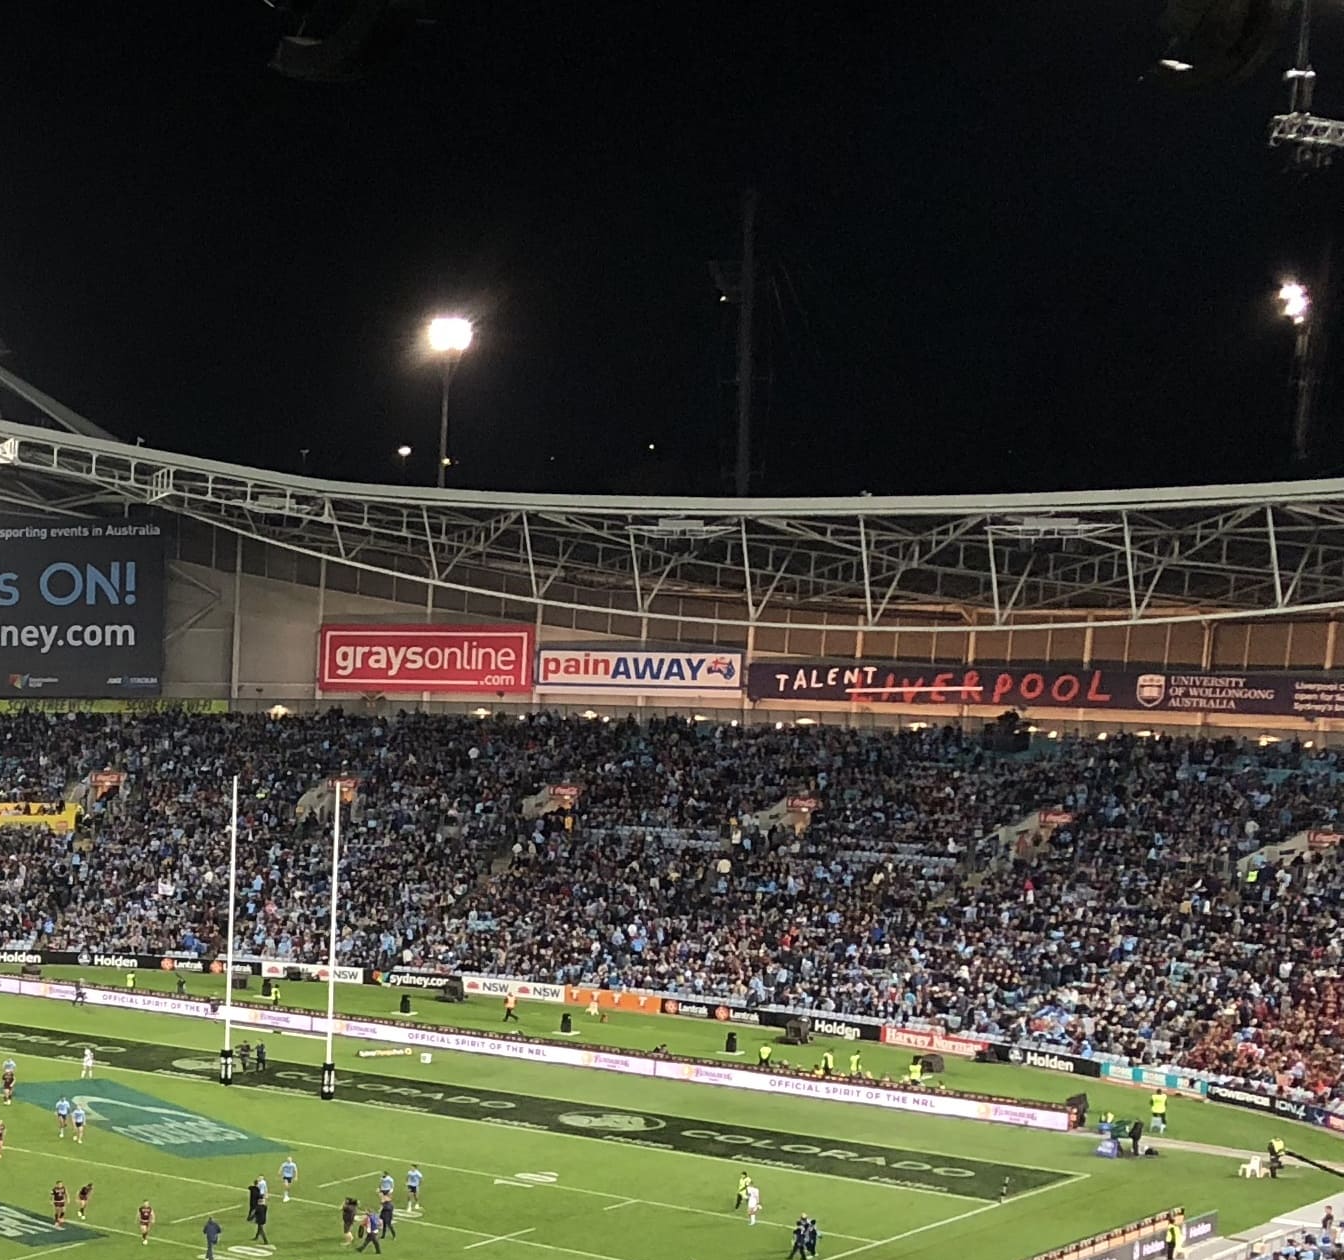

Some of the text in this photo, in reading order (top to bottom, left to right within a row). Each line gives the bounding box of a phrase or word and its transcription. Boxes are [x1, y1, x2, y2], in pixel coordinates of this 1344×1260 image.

[0, 526, 48, 540] sporting
[50, 526, 90, 538] events
[92, 526, 102, 536] in
[106, 524, 160, 536] Australia
[39, 561, 136, 606] ON!
[335, 640, 516, 676] graysonline
[542, 652, 706, 682] painAWAY
[478, 672, 515, 686] .com
[775, 666, 1112, 704] TALENT LIVERPOOL
[1170, 676, 1246, 688] UNIVERSITY
[1169, 687, 1274, 700] OF WOLLONGONG
[1168, 698, 1236, 710] AUSTRALIA
[93, 954, 138, 968] Holden
[173, 958, 204, 972] Lantrak
[482, 981, 510, 994] NSW
[532, 986, 561, 998] NSW
[678, 1002, 709, 1017] Lantrak
[728, 1008, 760, 1022] Lantrak
[814, 1019, 861, 1040] Holden
[407, 1032, 548, 1057] OFFICIAL SPIRIT OF THE NRL
[885, 1027, 983, 1054] Harvey Norman
[1026, 1052, 1075, 1072] Holden
[768, 1078, 936, 1108] OFFICIAL SPIRIT OF THE NRL
[1212, 1086, 1307, 1119] POWERADE ION4
[680, 1128, 977, 1179] COLORADO
[1189, 1222, 1212, 1238] Holden
